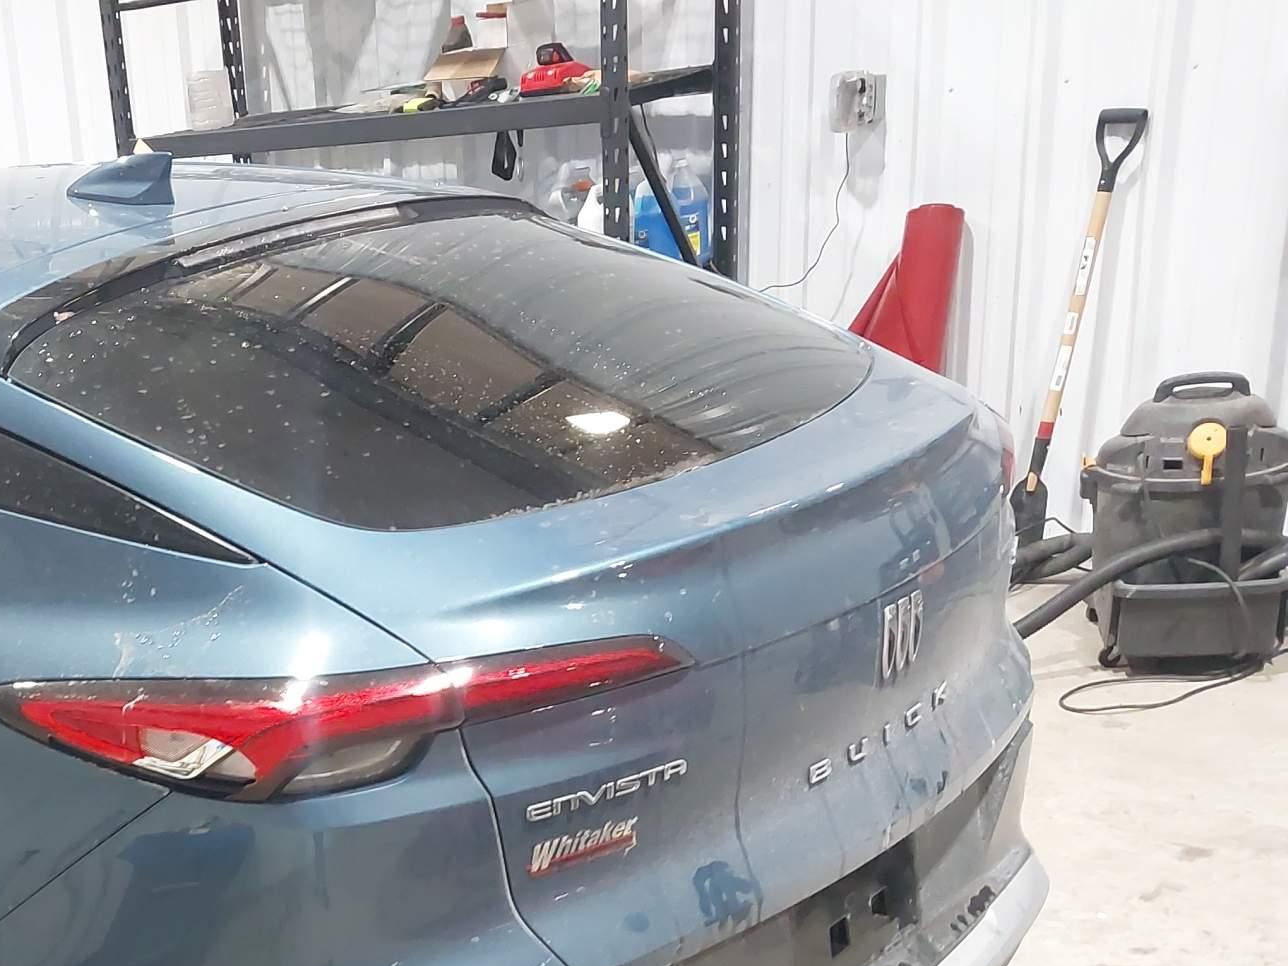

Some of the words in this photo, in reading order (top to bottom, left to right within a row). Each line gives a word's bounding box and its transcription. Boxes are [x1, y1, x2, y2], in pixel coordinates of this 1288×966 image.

[808, 680, 949, 787] BUICK
[526, 758, 689, 822] ENVISTA
[531, 815, 639, 873] Whitaker
